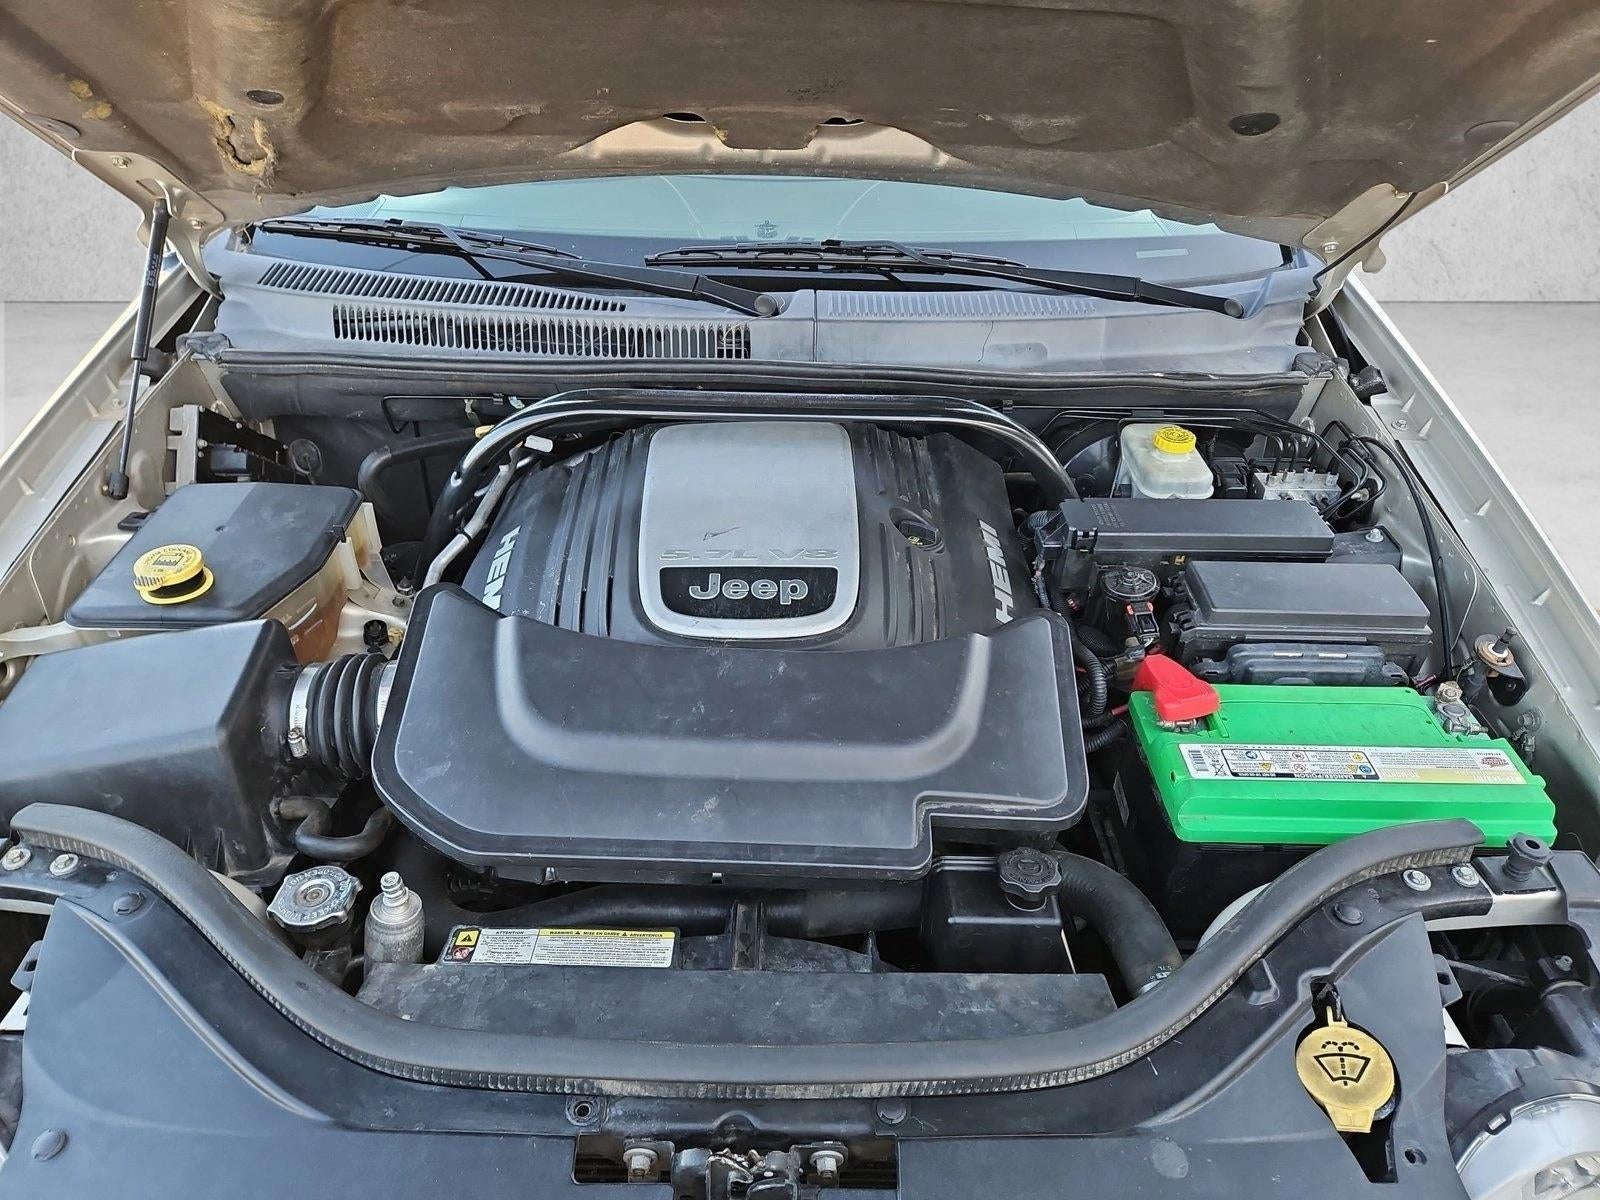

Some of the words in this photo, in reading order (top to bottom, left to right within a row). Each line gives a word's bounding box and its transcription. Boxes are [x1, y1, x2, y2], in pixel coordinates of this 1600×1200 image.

[482, 525, 522, 611] HEM
[659, 549, 759, 561] 5.7L
[768, 549, 840, 561] V8
[979, 519, 1014, 624] HEMI
[688, 572, 809, 605] Jeep
